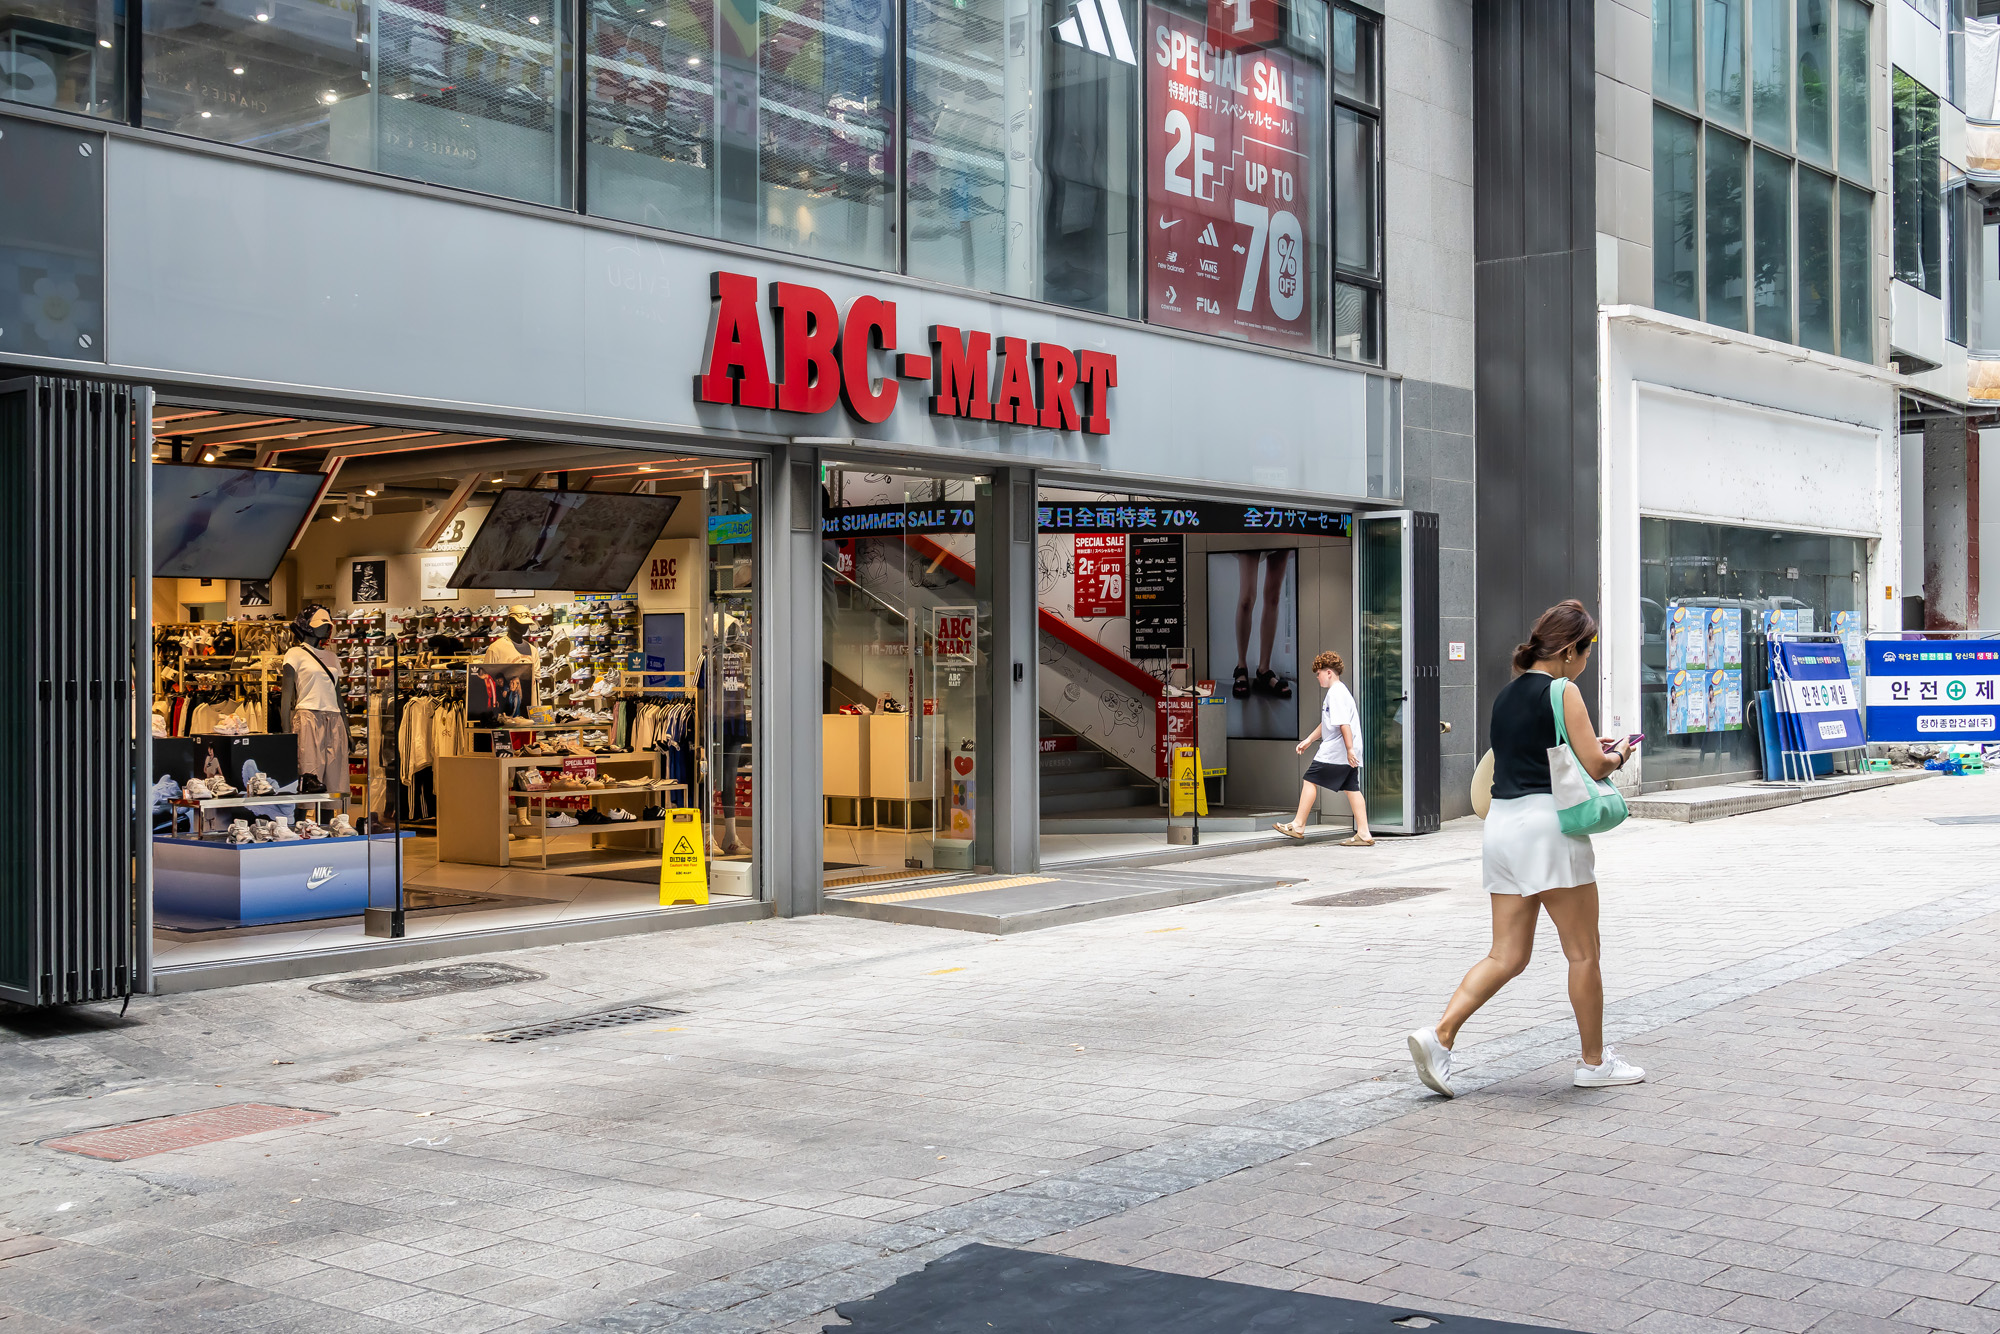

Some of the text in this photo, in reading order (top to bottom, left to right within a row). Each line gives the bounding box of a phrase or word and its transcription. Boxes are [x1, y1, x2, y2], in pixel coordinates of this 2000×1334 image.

[1156, 25, 1305, 114] SPECIAL SALE
[1165, 109, 1215, 199] 2F
[1246, 161, 1293, 202] UP TO
[1199, 258, 1218, 274] VANS
[1160, 303, 1182, 313] CONVERSE
[1196, 296, 1220, 315] FILA
[693, 271, 1118, 436] ABC-MART
[842, 512, 905, 531] SUMMER
[907, 509, 946, 528] SALE
[950, 508, 975, 526] 70
[1038, 506, 1200, 528] 夏日全面特卖 70%
[1075, 536, 1125, 548] SPECIAL SALE
[650, 558, 677, 577] ABC
[1079, 557, 1095, 575] 2F
[1101, 563, 1120, 572] UP TO
[650, 578, 677, 590] MART
[938, 617, 972, 639] ABC
[938, 640, 972, 655] MART
[1955, 652, 1975, 660] 당신의
[1158, 701, 1180, 709] SPECIAL
[1168, 715, 1184, 733] 2F
[1044, 740, 1057, 752] OFF
[564, 759, 583, 767] SPECIAL
[312, 866, 334, 880] NIKE
